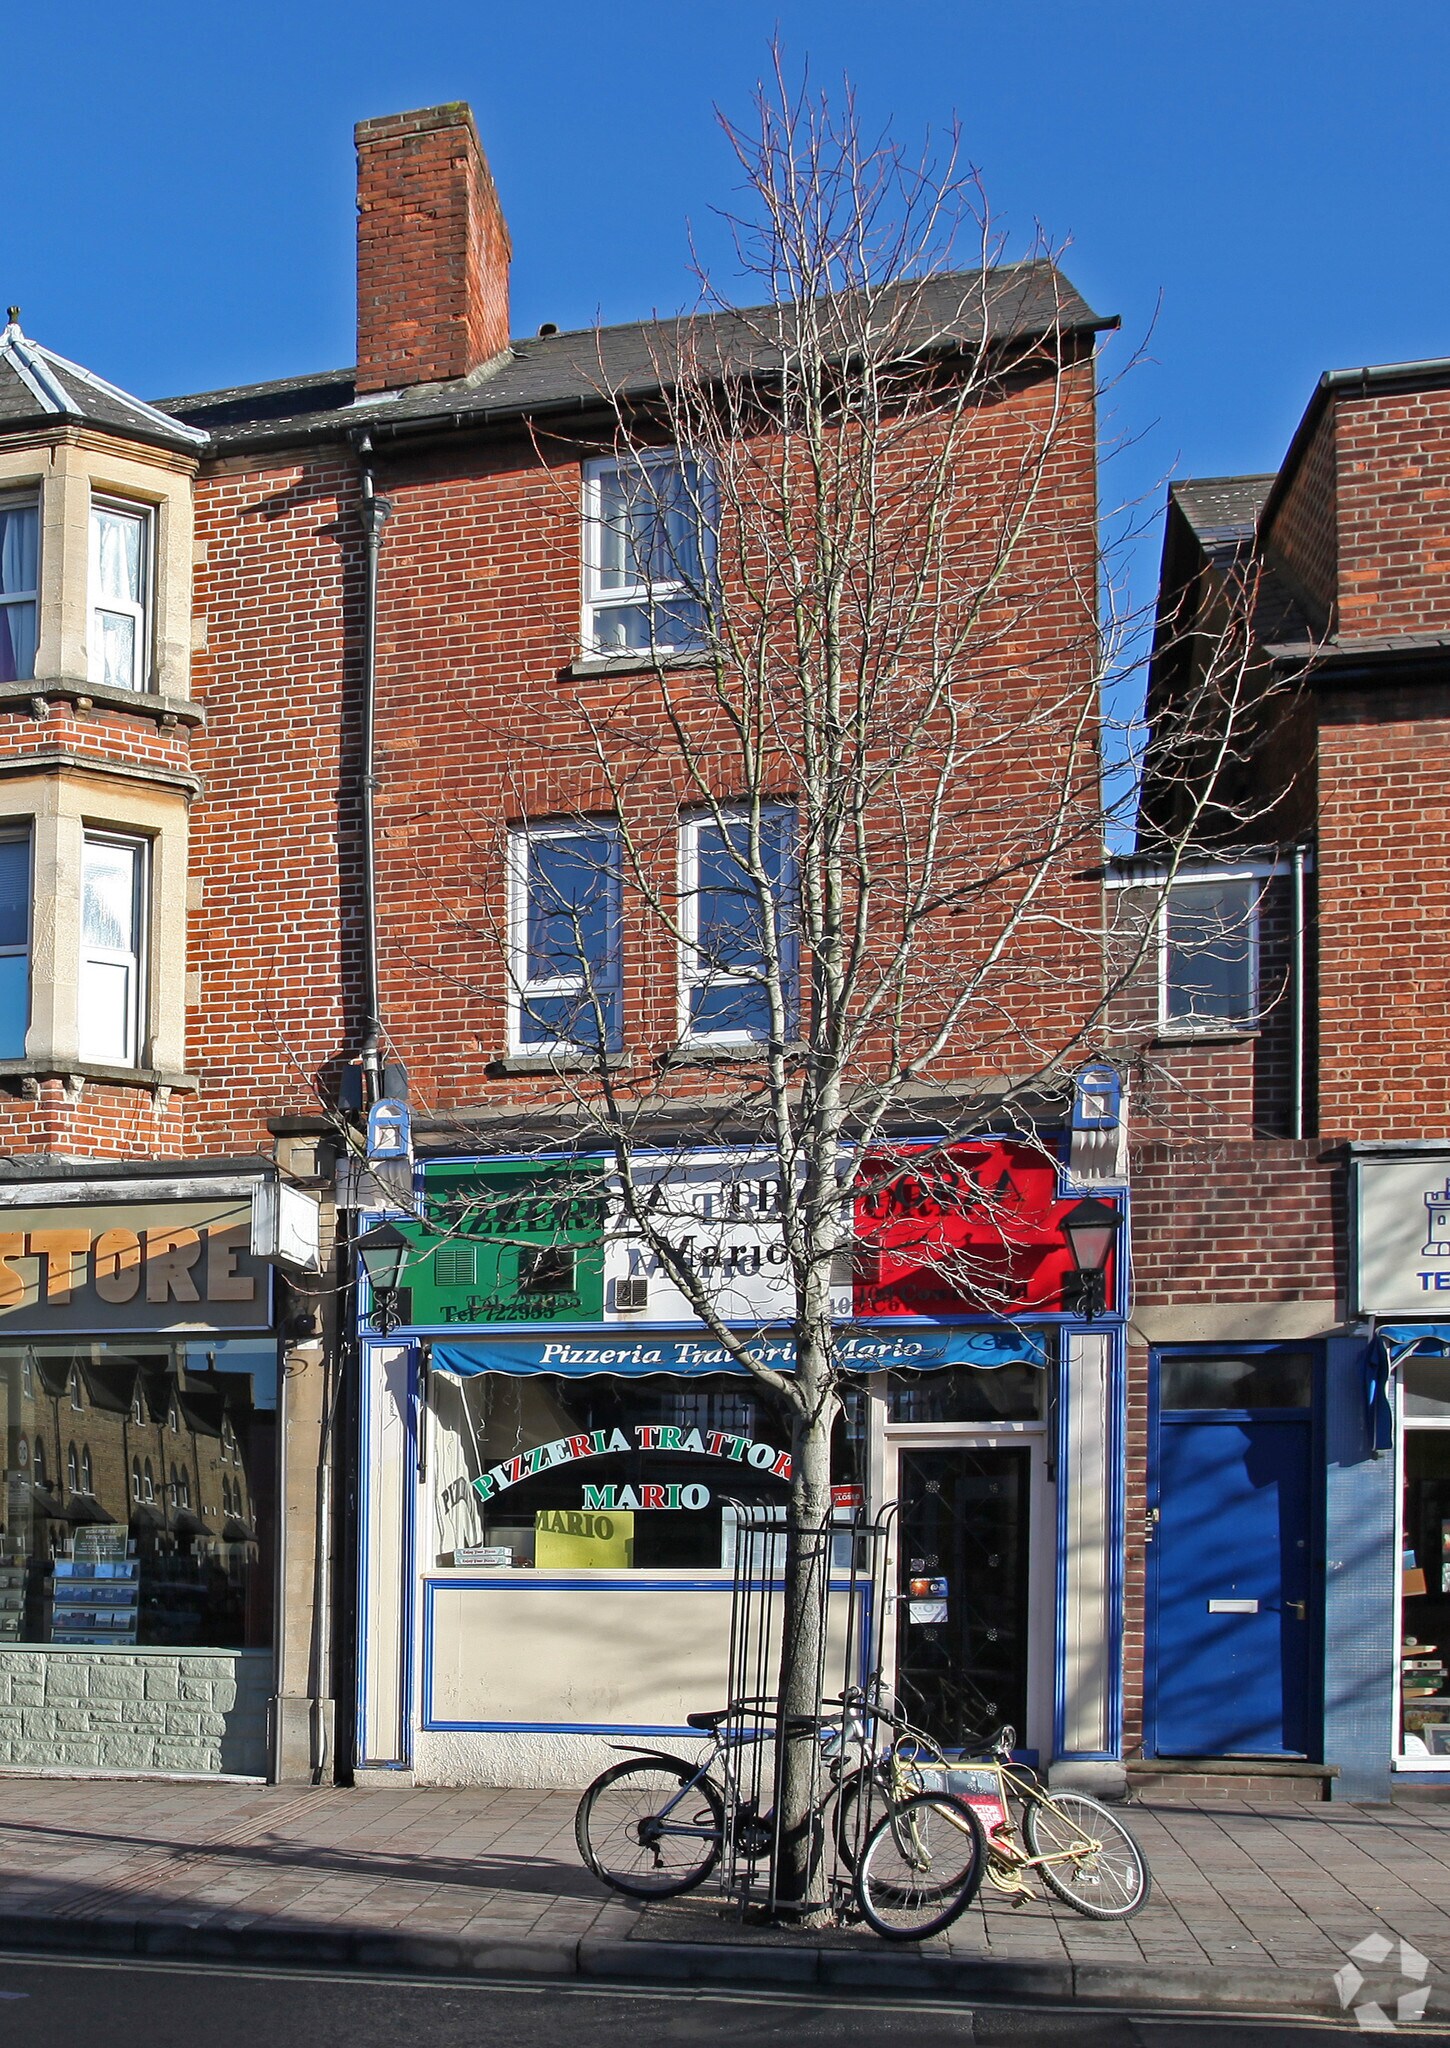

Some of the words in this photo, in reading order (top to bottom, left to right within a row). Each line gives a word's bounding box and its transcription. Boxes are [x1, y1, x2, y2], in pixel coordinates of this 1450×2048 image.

[539, 1344, 661, 1364] Pizzeria
[832, 1338, 922, 1359] Mario
[471, 1427, 631, 1502] PIZZERIA
[635, 1425, 793, 1481] TRATTOR
[582, 1484, 710, 1510] MARIO
